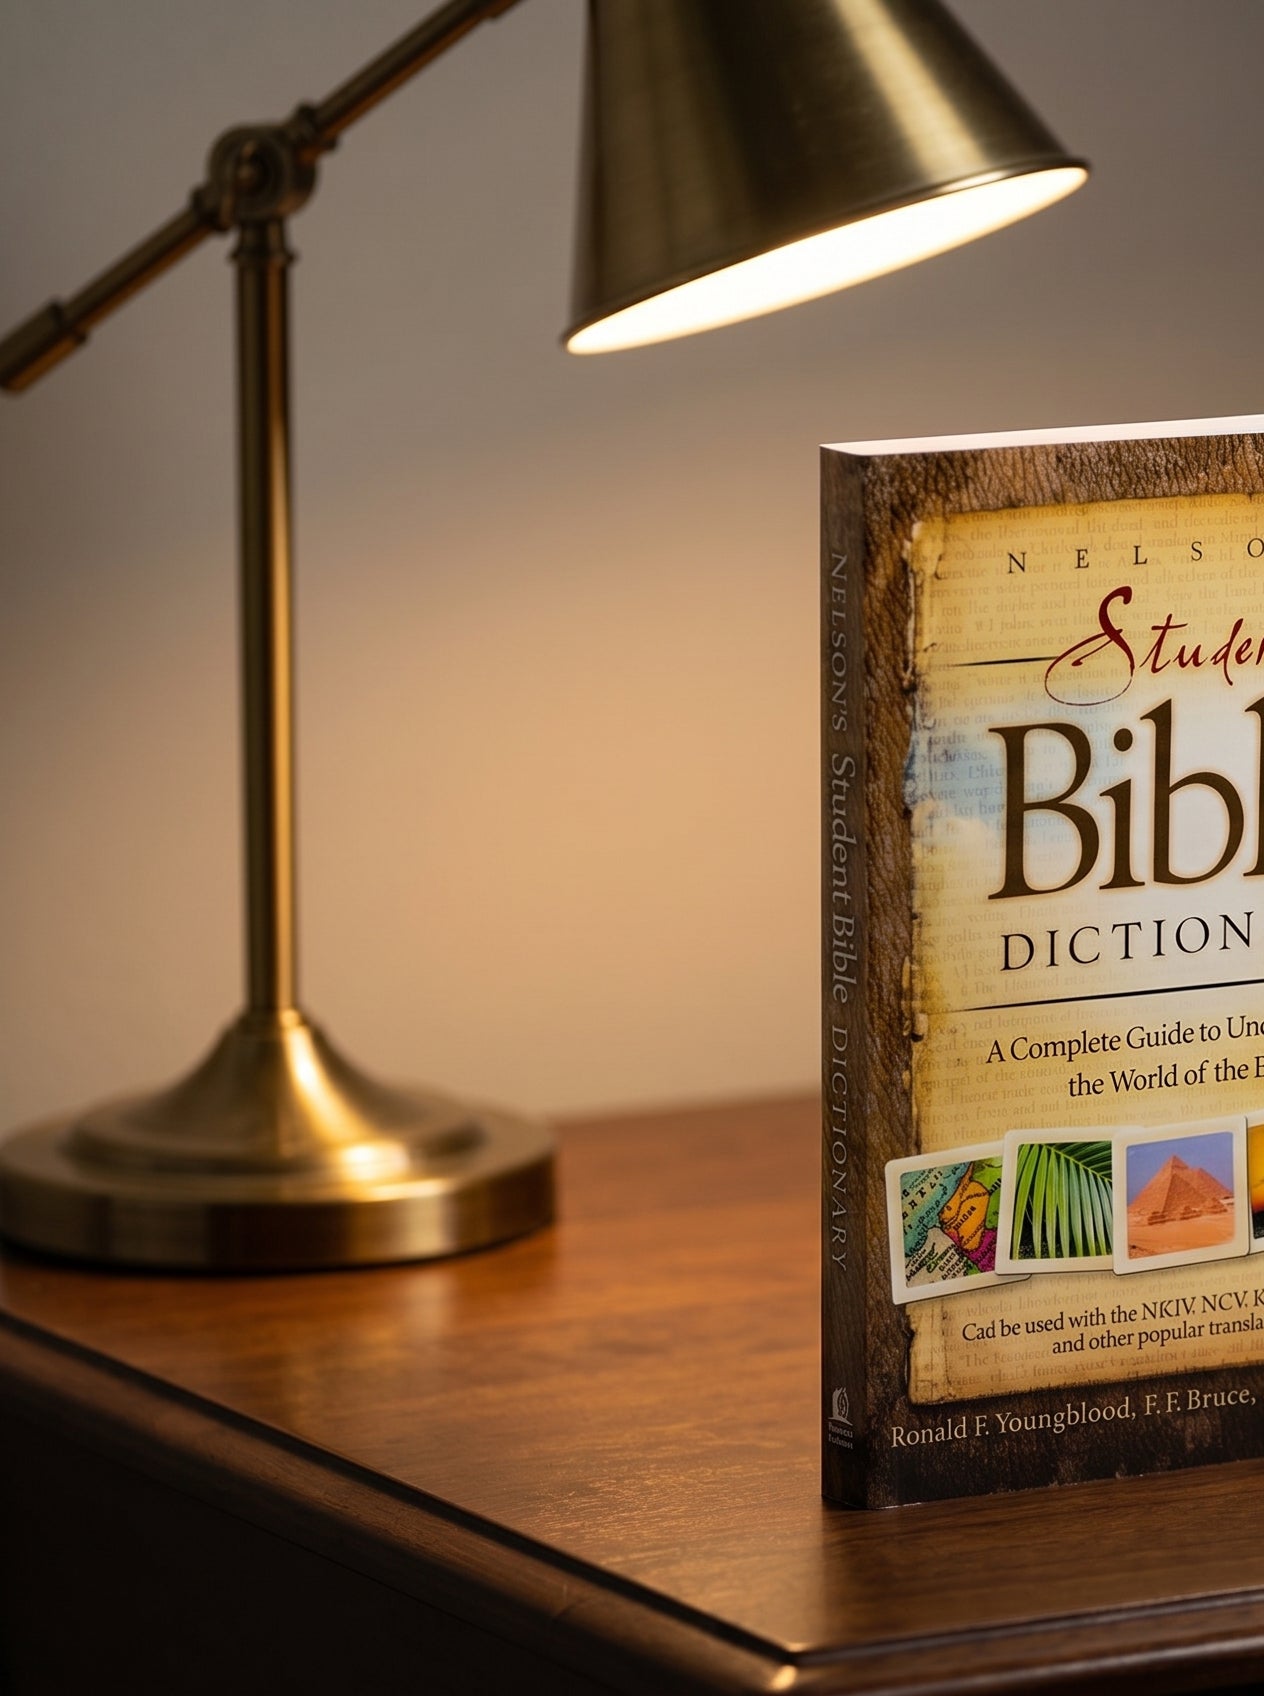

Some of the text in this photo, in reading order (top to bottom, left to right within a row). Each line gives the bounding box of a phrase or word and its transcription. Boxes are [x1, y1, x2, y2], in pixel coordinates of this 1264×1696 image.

[831, 552, 859, 1272] NELSON'S Student Bible DICTIONARY
[986, 1040, 1006, 1064] A
[1011, 1030, 1121, 1062] Complete
[1127, 1021, 1194, 1049] Guide
[1200, 1024, 1220, 1042] to
[1069, 1073, 1104, 1097] the
[1109, 1064, 1178, 1092] World
[1184, 1060, 1209, 1085] of
[1214, 1058, 1248, 1082] the
[963, 1320, 996, 1341] Cad
[1000, 1319, 1020, 1336] be
[1025, 1312, 1064, 1333] used
[1069, 1307, 1106, 1328] with
[1111, 1305, 1137, 1323] the
[1053, 1333, 1085, 1354] and
[1089, 1329, 1134, 1349] other
[1138, 1320, 1205, 1350] popular
[892, 1416, 967, 1447] Ronald
[975, 1415, 990, 1436] F.
[995, 1396, 1136, 1434] Youngblood,
[1145, 1395, 1160, 1415] F.
[1166, 1392, 1180, 1412] F.
[1187, 1389, 1256, 1410] Bruce,
